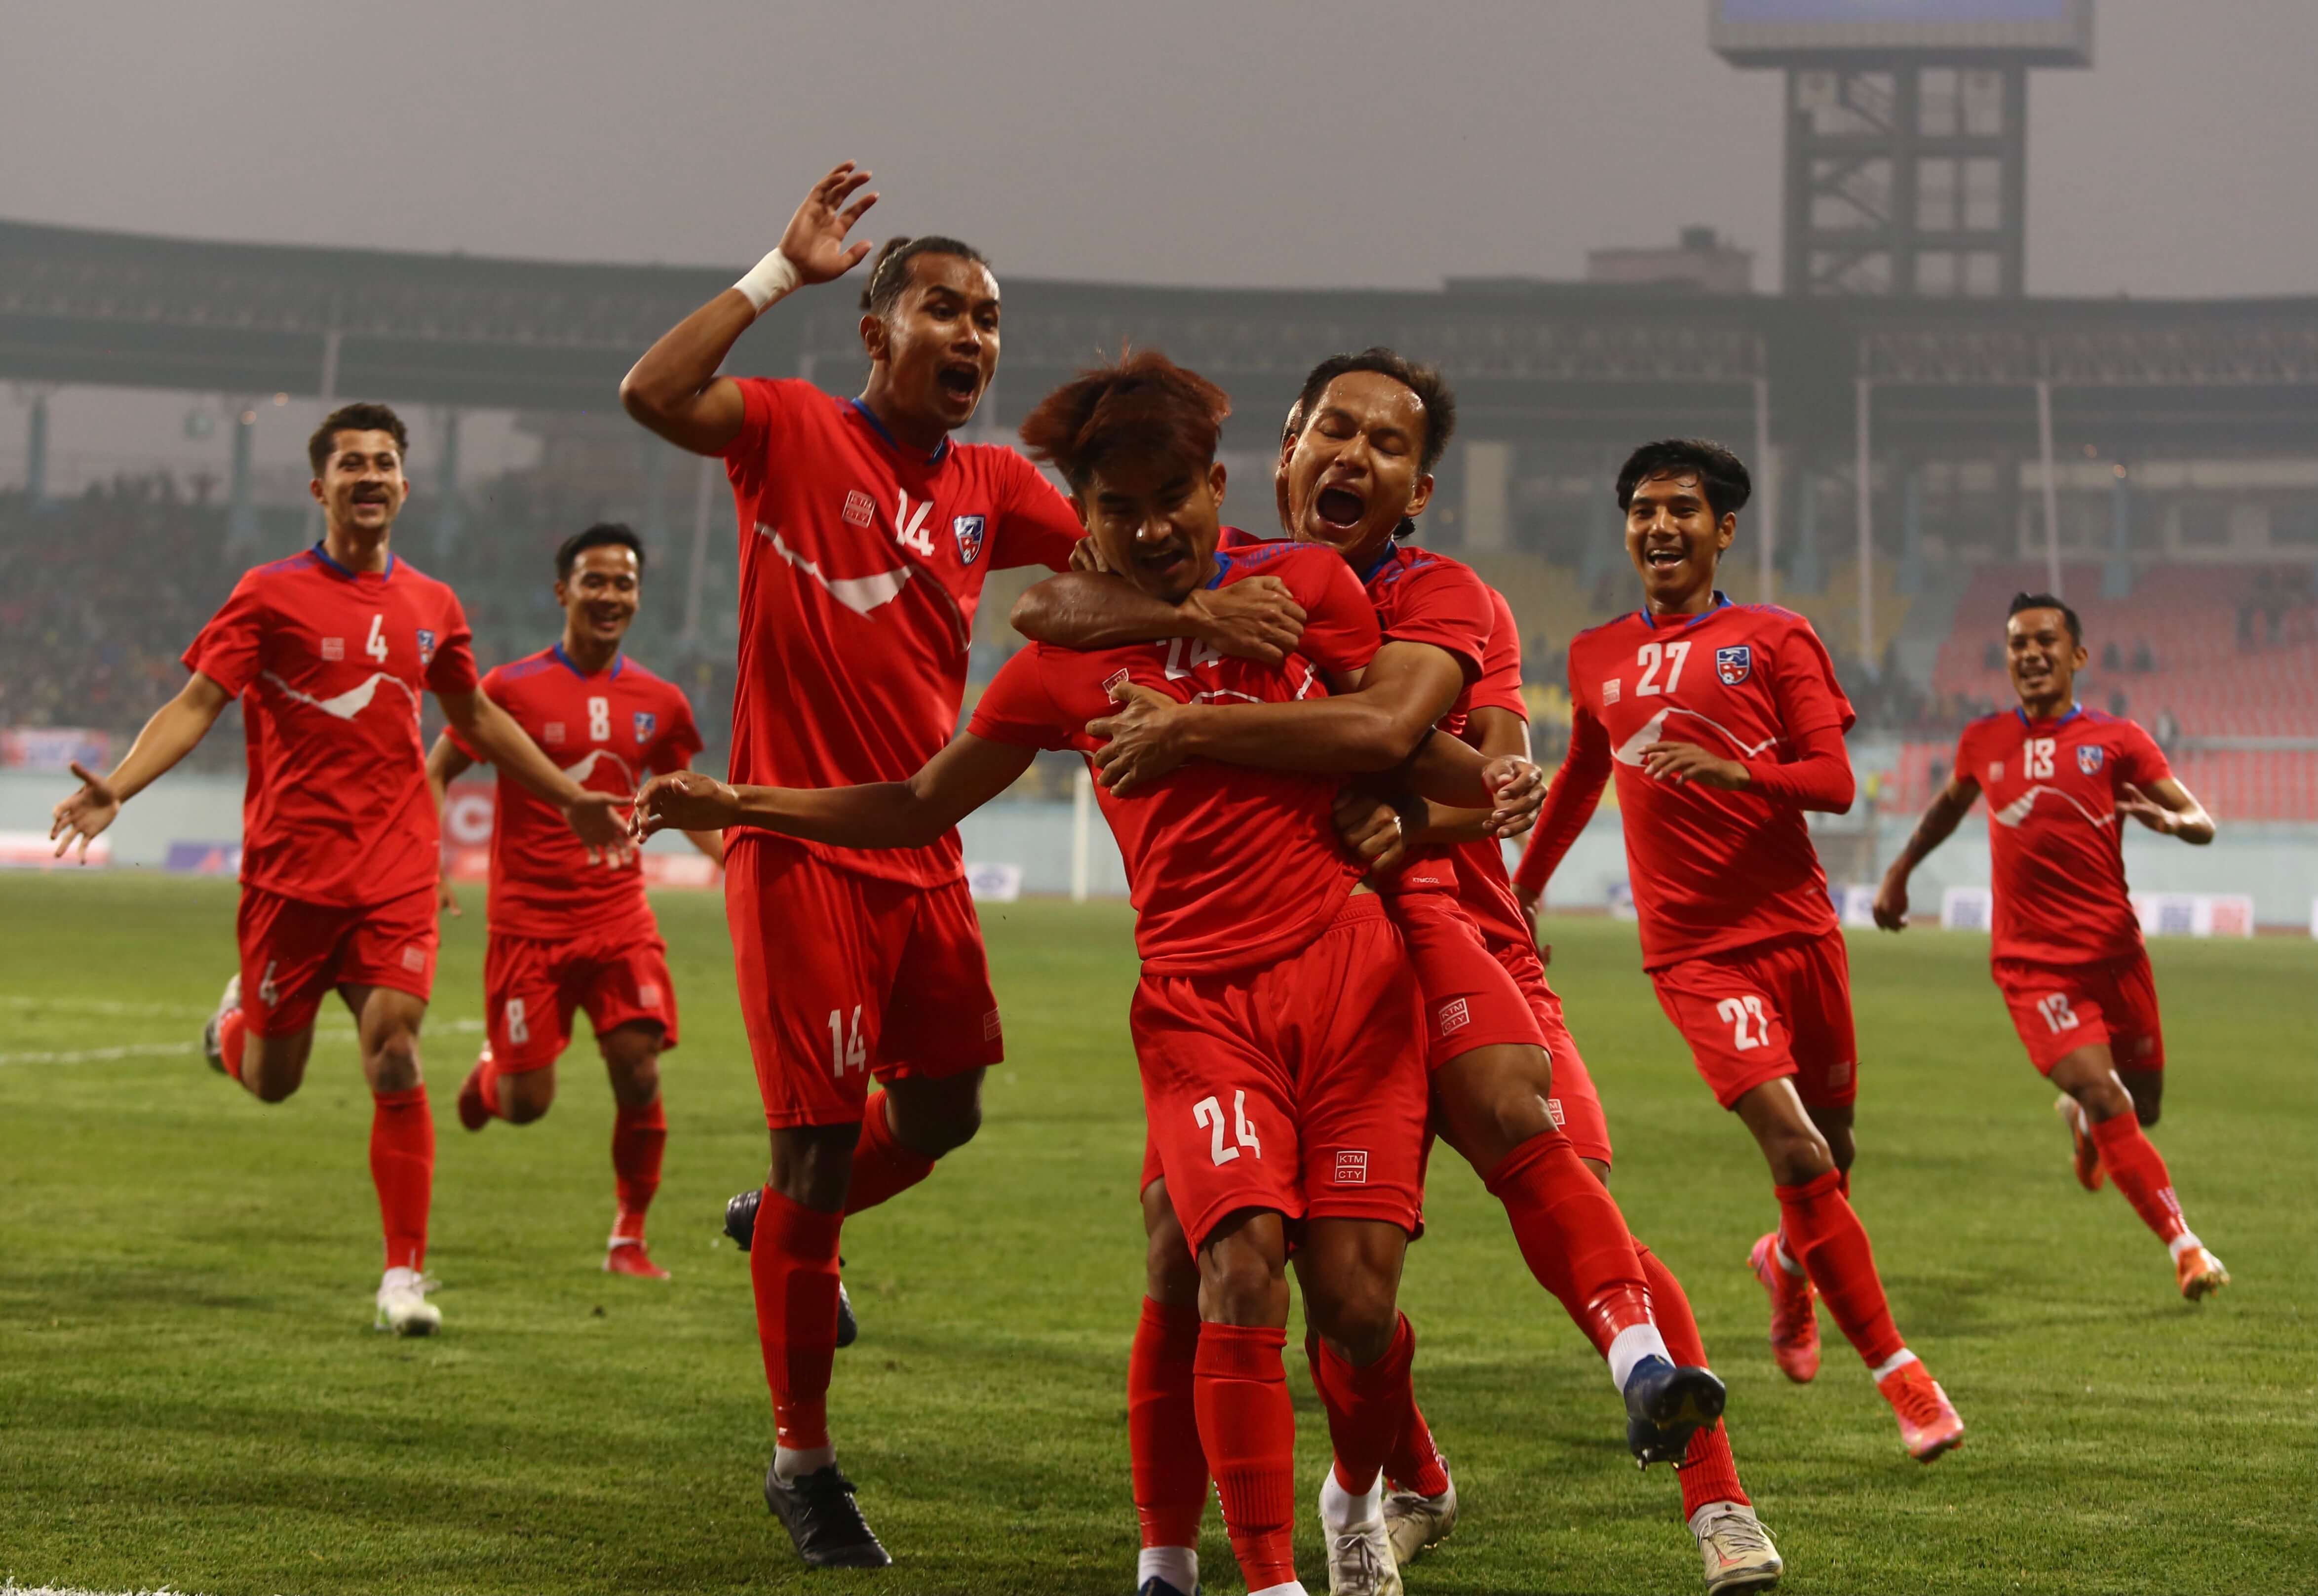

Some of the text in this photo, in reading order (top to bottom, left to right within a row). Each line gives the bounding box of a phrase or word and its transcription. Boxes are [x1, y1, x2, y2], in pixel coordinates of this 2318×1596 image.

[895, 488, 934, 556] 14
[366, 614, 388, 663] 4
[1636, 641, 1691, 697] 27
[588, 697, 610, 740] 8
[2023, 738, 2055, 779] 13
[259, 961, 278, 1007] 4
[507, 998, 528, 1044] 8
[1442, 1003, 1463, 1019] KTM
[1444, 1014, 1465, 1031] CTY
[1716, 995, 1769, 1051] 27
[2037, 993, 2079, 1034] 13
[828, 1004, 866, 1078] 14
[1193, 1090, 1261, 1167] 24
[1338, 1170, 1362, 1179] CTY
[1339, 1155, 1363, 1163] KTM
